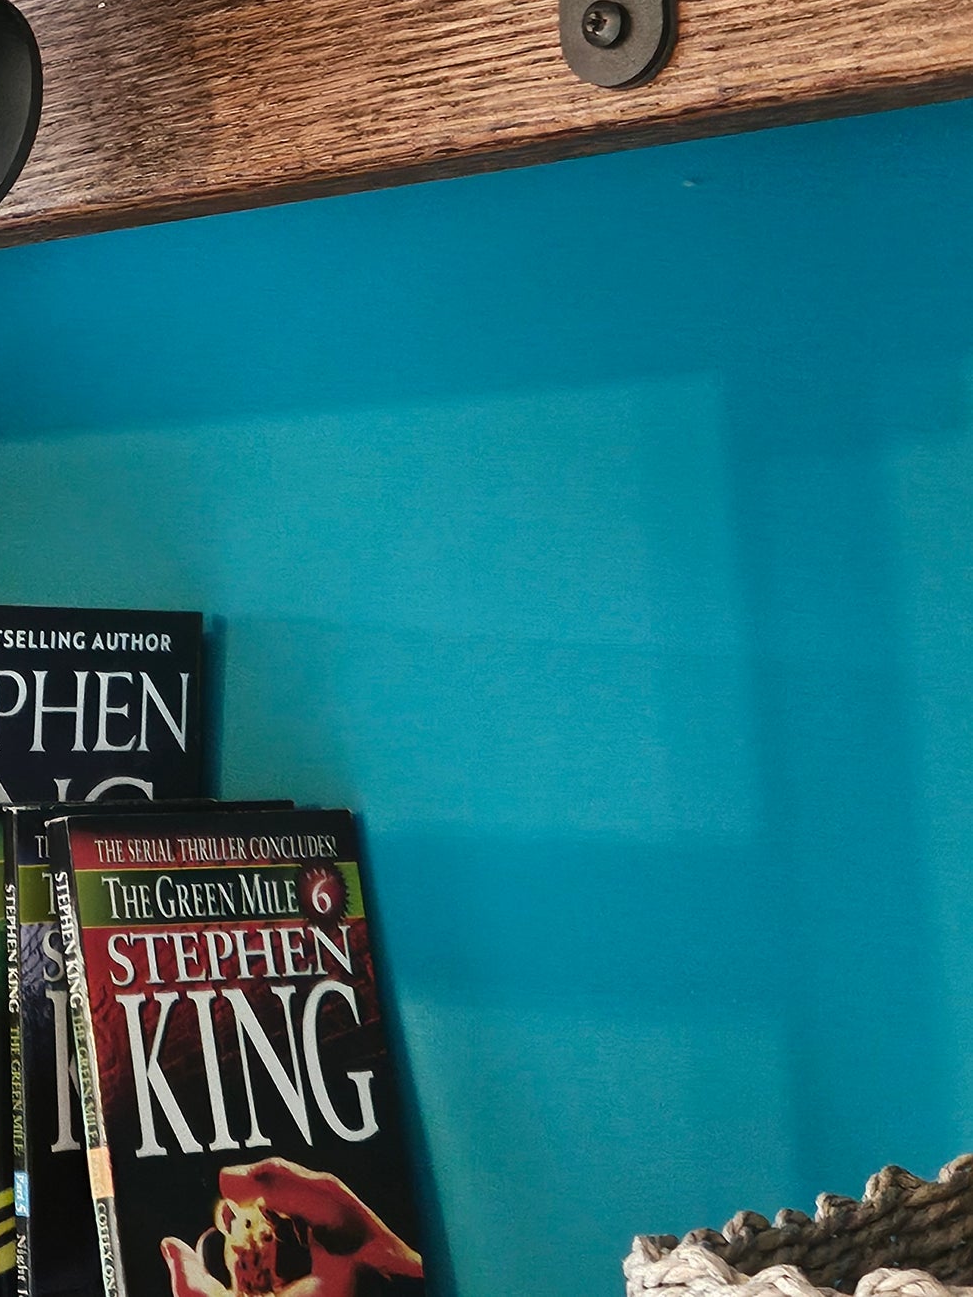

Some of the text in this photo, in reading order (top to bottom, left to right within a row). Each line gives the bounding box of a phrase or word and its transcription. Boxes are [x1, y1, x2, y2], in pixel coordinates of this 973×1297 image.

[91, 631, 173, 653] AUTHOR
[93, 834, 339, 863] THE SERIAL THRILLER CONCLUDES!
[5, 883, 19, 963] STEPHEN
[101, 874, 157, 920] THE
[155, 874, 236, 919] GREEN
[238, 872, 300, 916] MILE
[311, 877, 332, 915] 6
[54, 871, 76, 956] STEPHEN
[65, 958, 85, 1009] KING
[106, 923, 357, 987] STEPHEN
[7, 965, 20, 1014] KING
[114, 978, 380, 1159] KING
